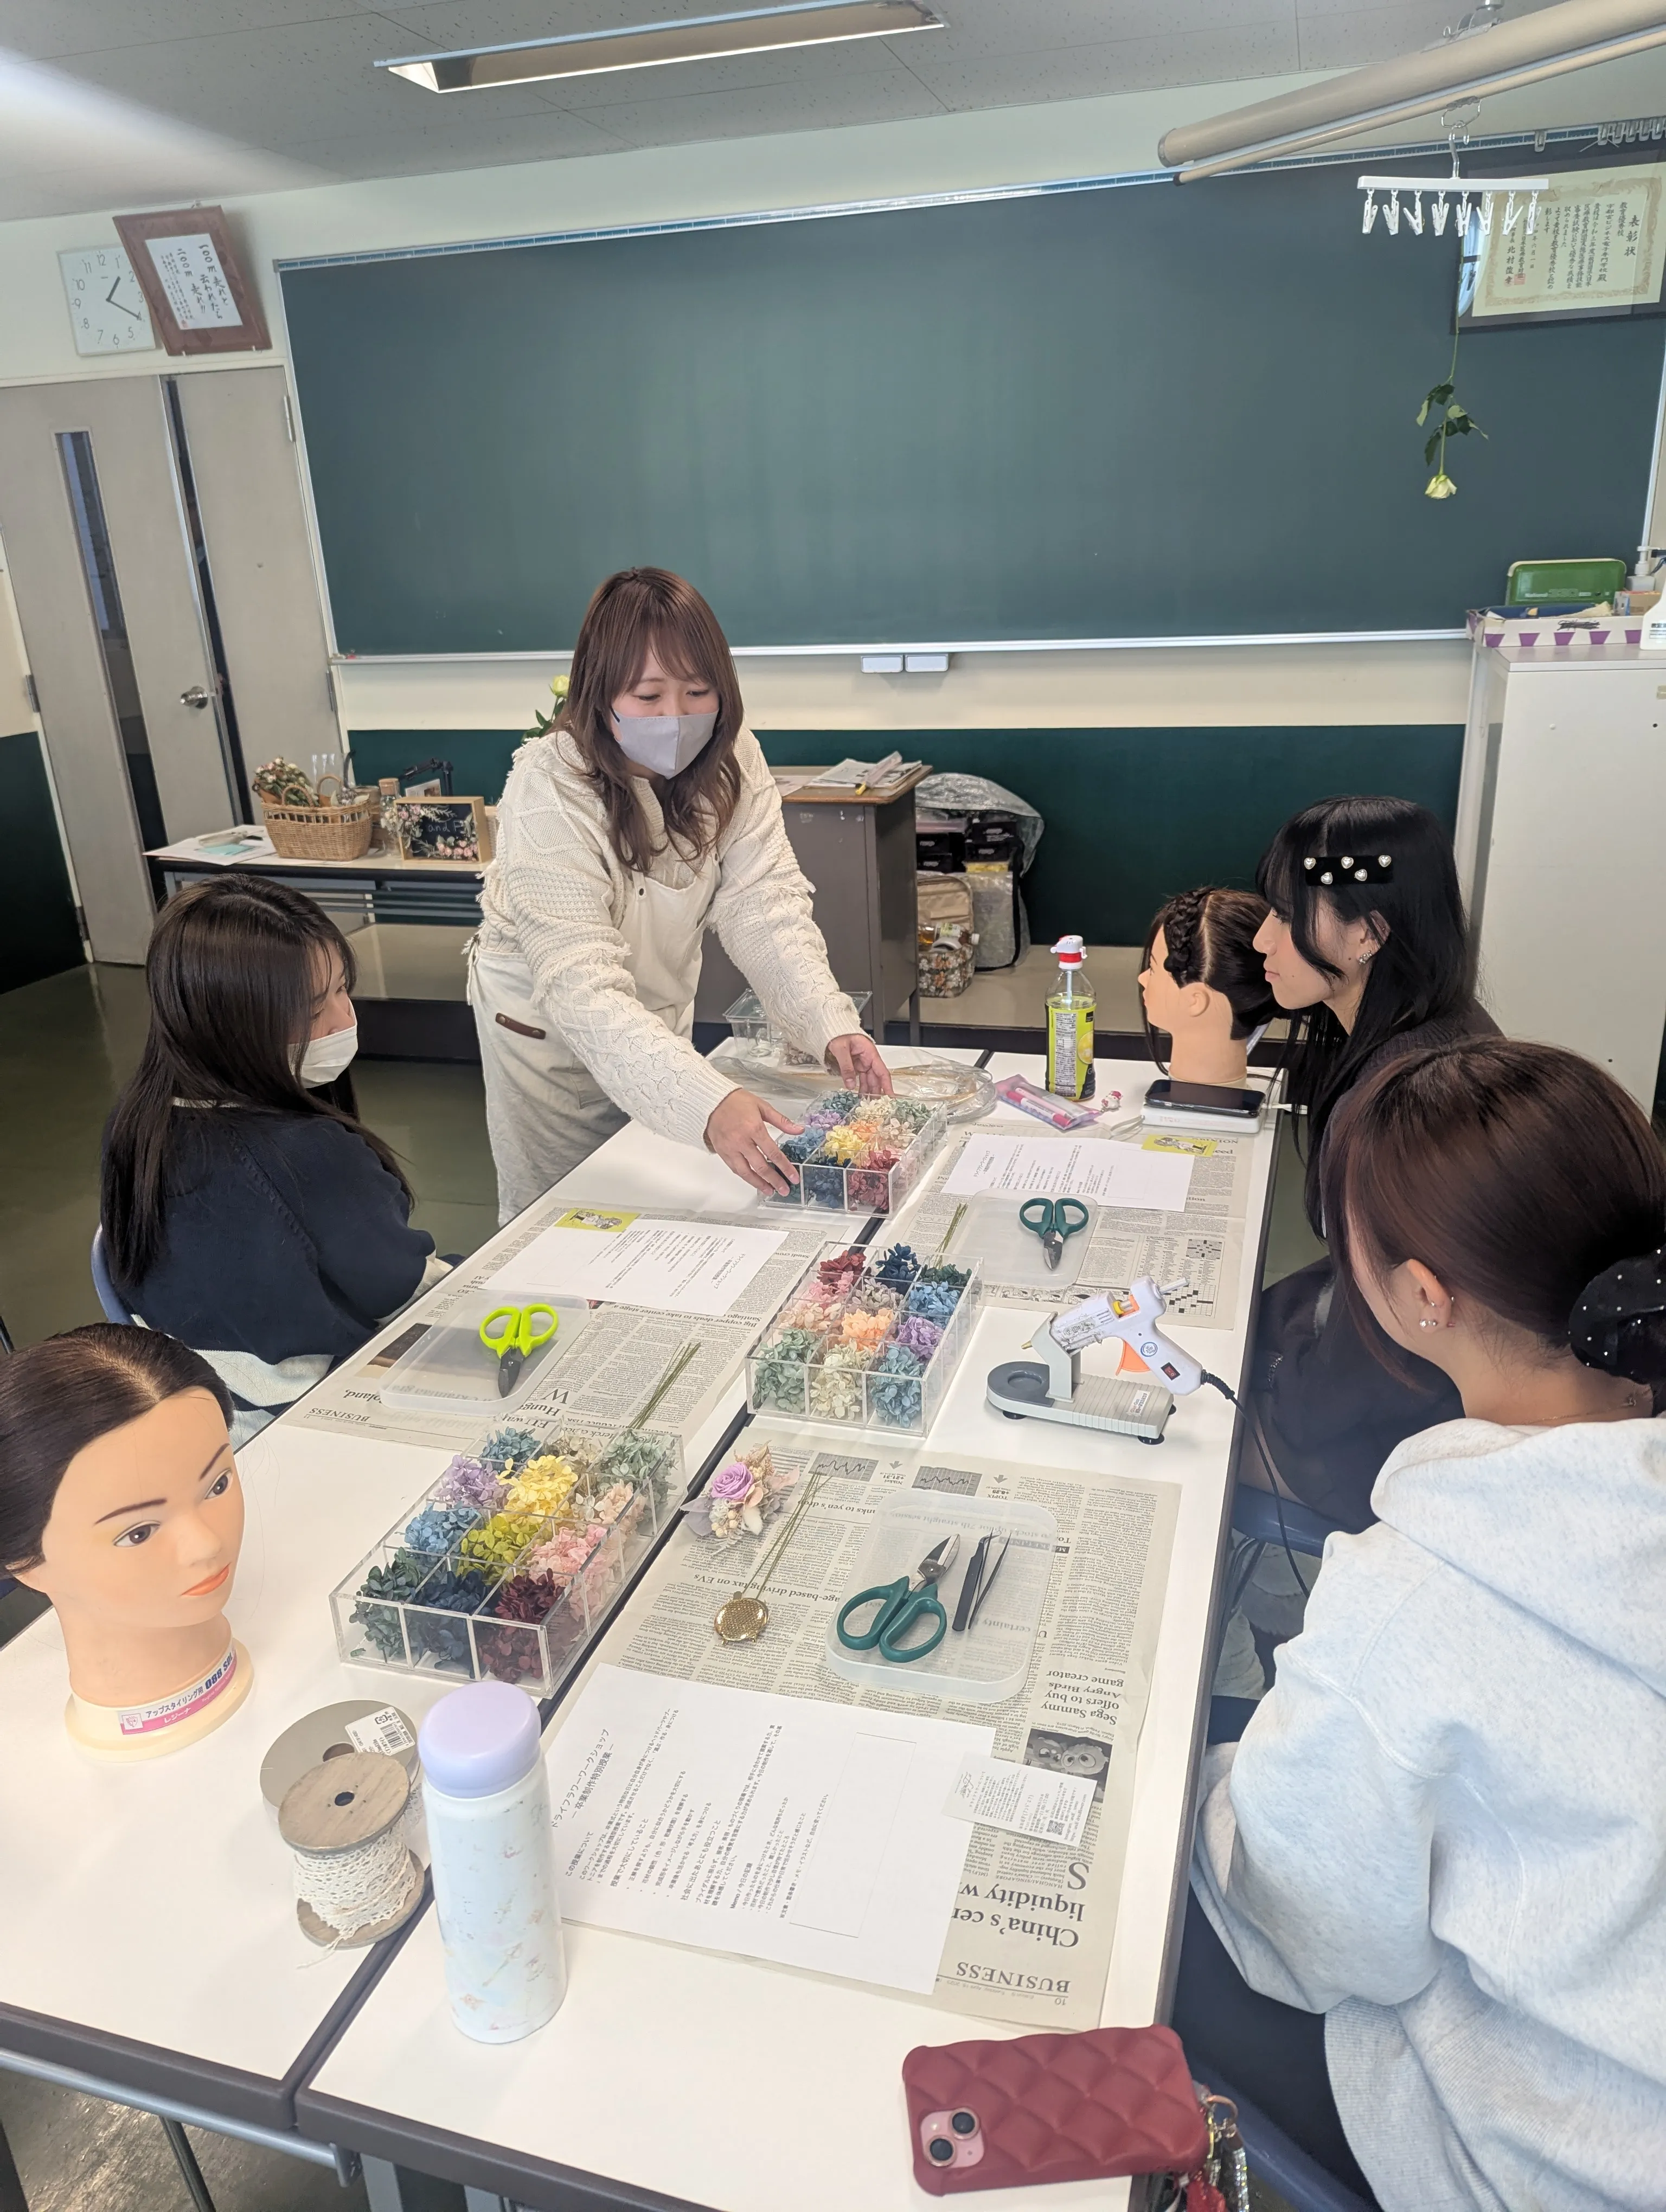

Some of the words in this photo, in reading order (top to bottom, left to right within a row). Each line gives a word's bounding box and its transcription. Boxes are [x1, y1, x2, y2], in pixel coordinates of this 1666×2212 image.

[1624, 215, 1639, 256] 表彰状
[97, 254, 106, 266] 12
[84, 262, 92, 273] 11
[130, 271, 134, 282] 2
[75, 279, 85, 291] 10
[138, 292, 144, 303] 3
[74, 299, 81, 309] 9
[84, 319, 89, 329] 8
[97, 330, 103, 342] 7
[128, 327, 134, 339] 5
[113, 335, 120, 345] 6
[427, 822, 451, 832] and
[727, 1314, 761, 1322] Santiago
[309, 1408, 371, 1422] BUSINESS
[694, 1574, 715, 1584] EVs
[1046, 1671, 1088, 1681] creator
[1091, 1677, 1124, 1687] game
[145, 1686, 204, 1718] アップスタイリング用
[205, 1668, 222, 1690] 088
[1049, 1682, 1080, 1693] Birds
[1083, 1686, 1121, 1698] Angry
[1045, 1690, 1067, 1702] buy
[1071, 1696, 1082, 1704] to
[1041, 1701, 1087, 1718] Sammy
[1086, 1698, 1119, 1709] offers
[164, 1707, 191, 1724] レジーナ
[1091, 1709, 1117, 1725] Sega
[548, 1729, 608, 1828] ドライフラワーワークショップ
[574, 1752, 612, 1809] 卒業制作特別授業
[565, 1831, 593, 1876] この授業について
[610, 1818, 649, 1887] 授業で大切にしていること
[680, 1820, 721, 1900] 社会に出たあとにも役立つこと
[1067, 1860, 1091, 1890] S
[730, 1894, 740, 1908] Memo
[738, 1863, 753, 1888] 今日の記録
[958, 1882, 979, 1896] w
[984, 1883, 1085, 1921] liquidity
[991, 1914, 1079, 1947] China's
[957, 1962, 1071, 1993] BUSINESS
[1054, 1997, 1066, 2005] 10
